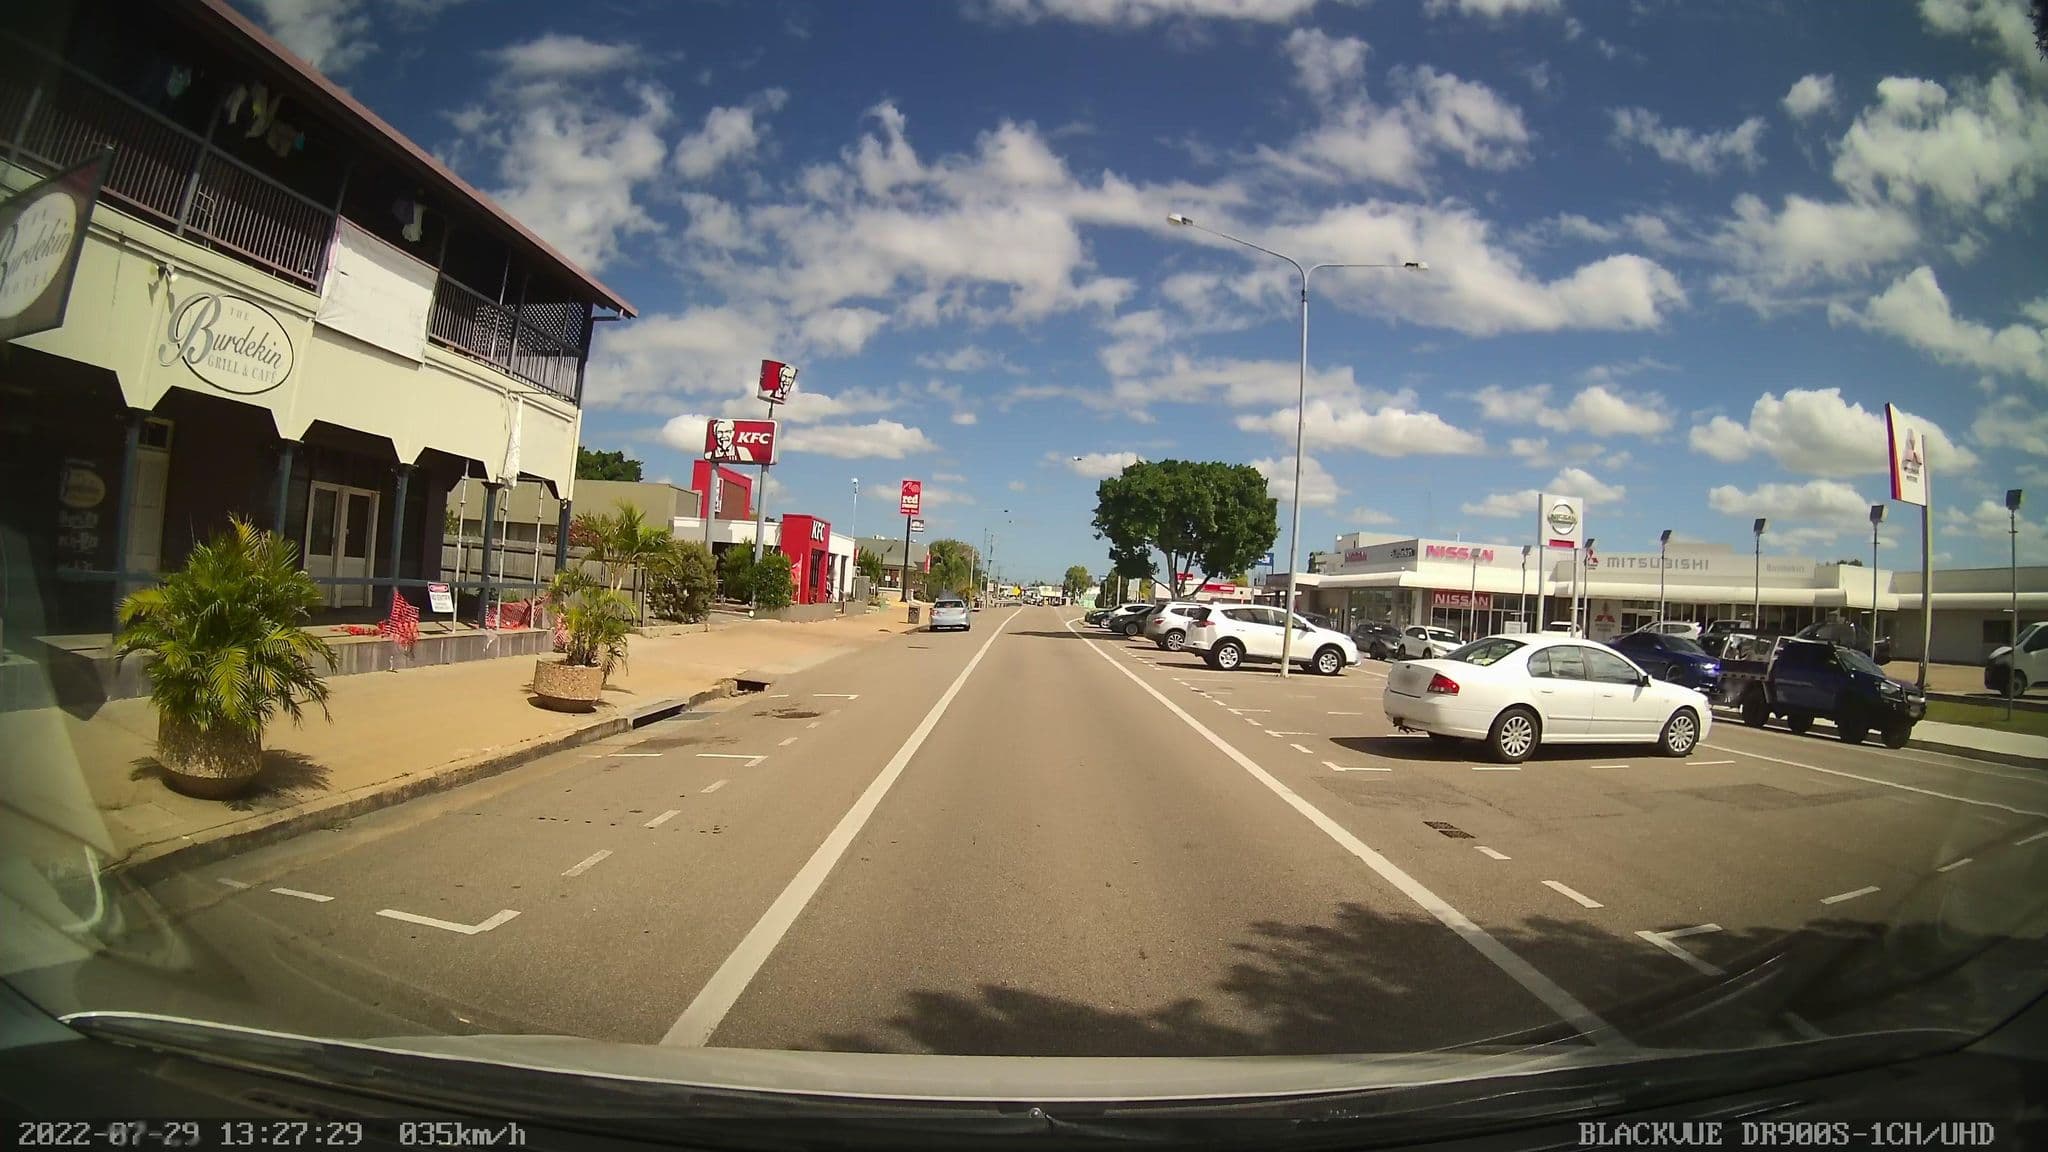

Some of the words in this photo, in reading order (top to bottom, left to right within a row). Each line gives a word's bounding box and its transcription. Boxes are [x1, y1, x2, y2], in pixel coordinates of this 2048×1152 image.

[159, 292, 282, 369] Burdekin
[207, 354, 239, 375] GRILL
[737, 432, 771, 444] KFC
[902, 494, 919, 504] red
[811, 520, 826, 542] KFC
[1607, 557, 1709, 571] MITSUBISHI
[1434, 593, 1489, 607] NISSAN
